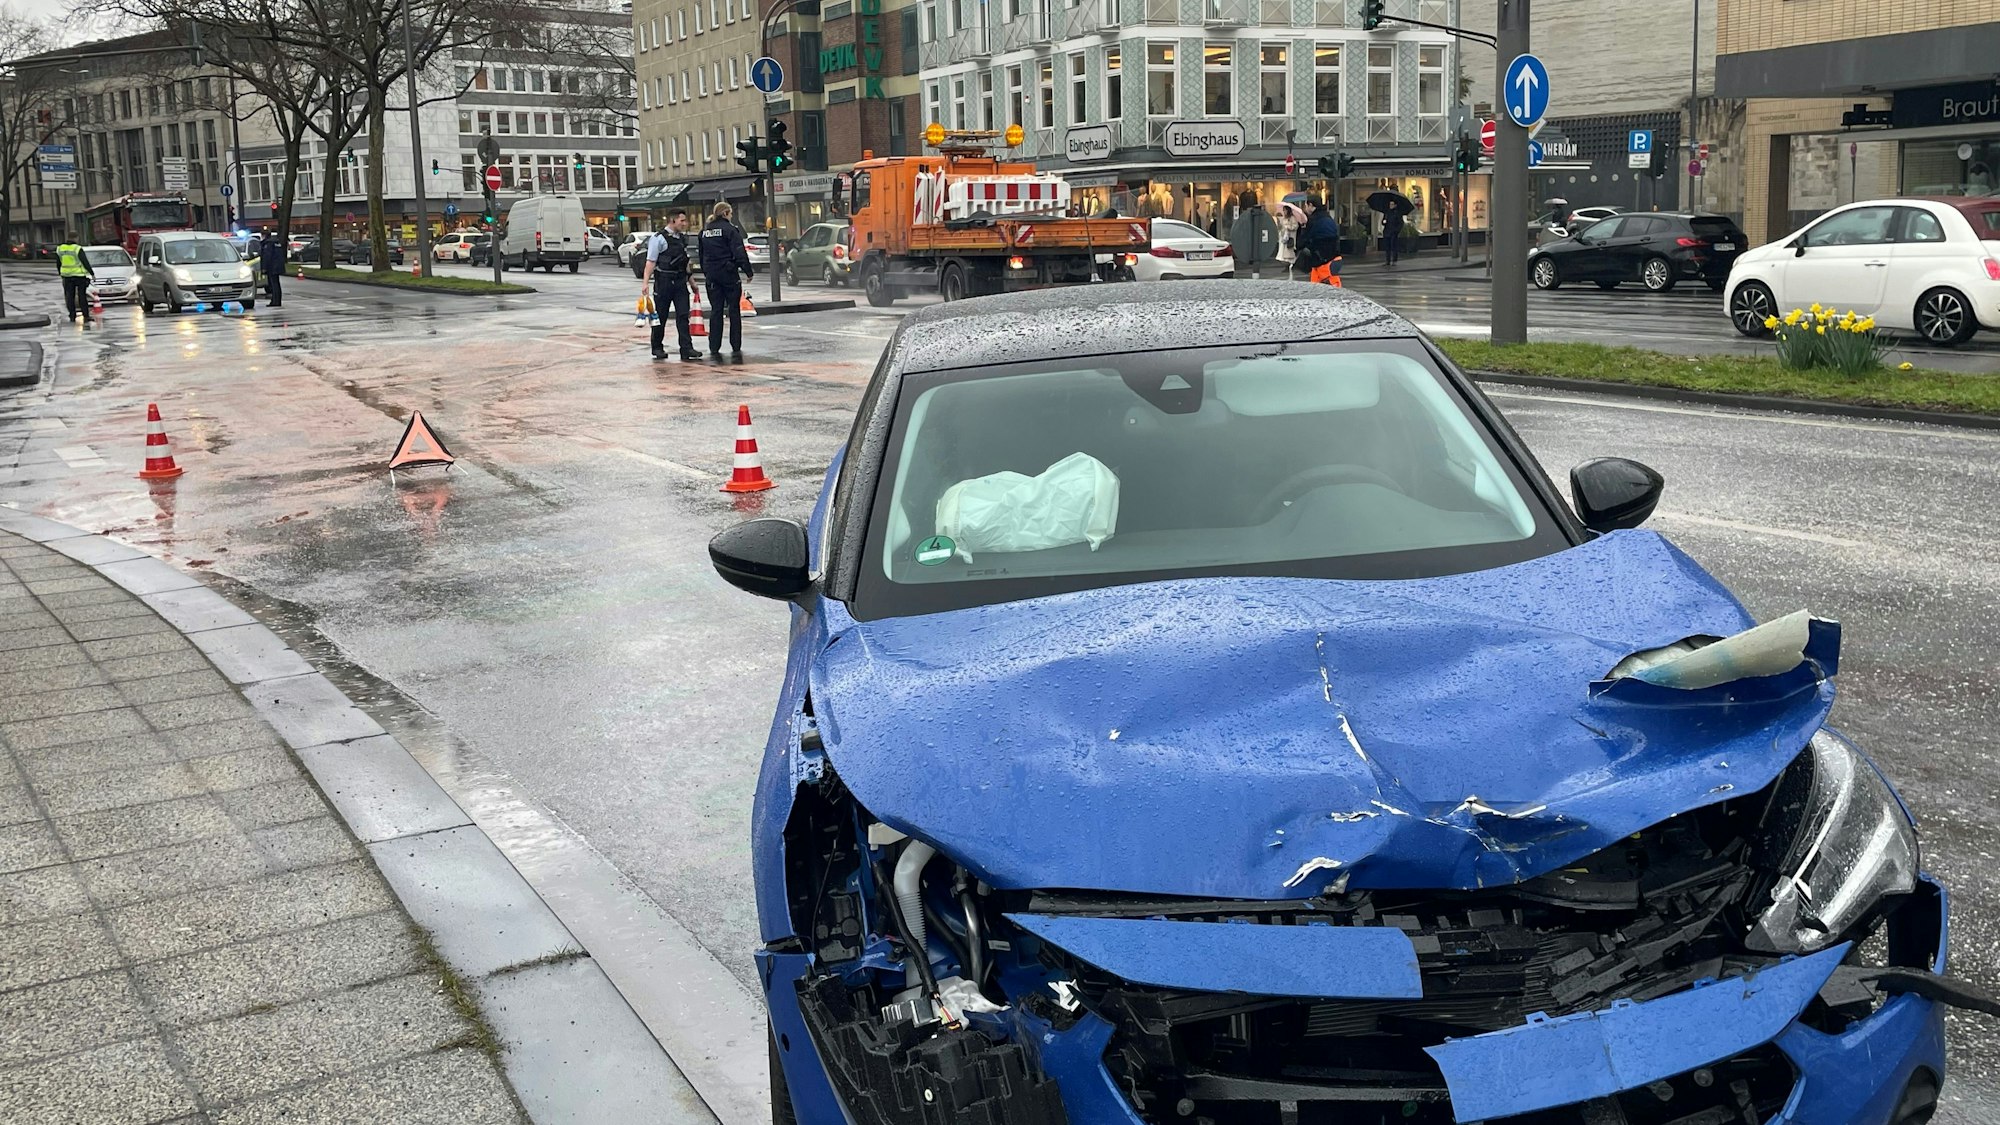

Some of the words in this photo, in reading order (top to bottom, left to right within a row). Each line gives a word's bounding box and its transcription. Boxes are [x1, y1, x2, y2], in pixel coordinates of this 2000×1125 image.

[861, 0, 885, 99] DEVK
[819, 43, 857, 74] DEVK
[1943, 94, 2000, 118] Braut
[1069, 138, 1108, 155] Ebinghaus
[1173, 132, 1239, 150] Ebinghaus
[1540, 143, 1578, 157] AHERIAN
[702, 228, 723, 238] POLIZEI
[929, 537, 941, 550] 4
